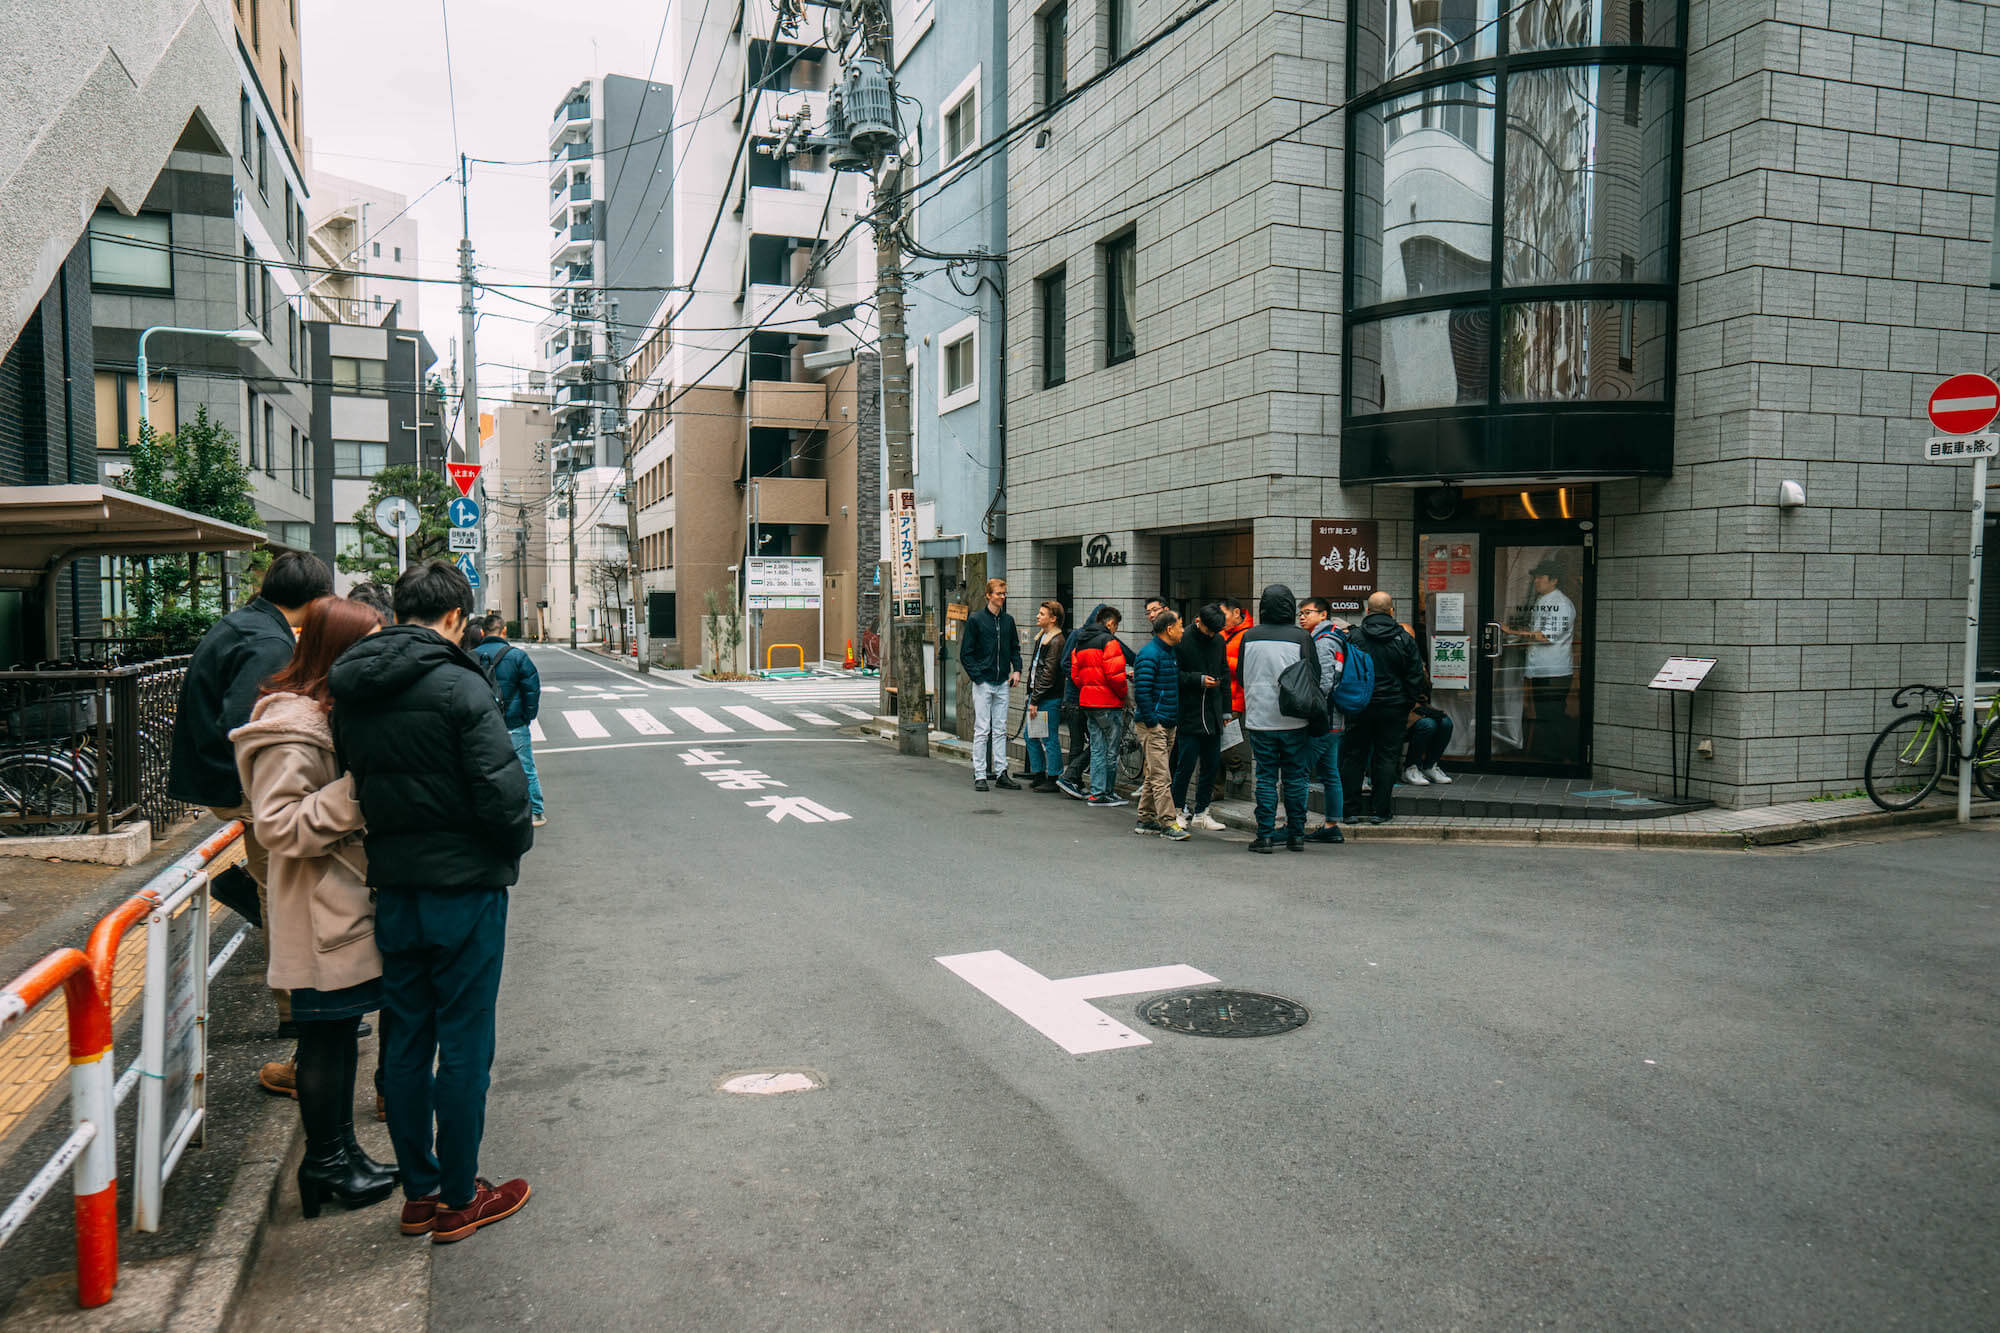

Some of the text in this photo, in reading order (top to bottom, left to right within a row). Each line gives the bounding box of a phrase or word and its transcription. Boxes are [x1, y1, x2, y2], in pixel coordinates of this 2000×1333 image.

[1930, 439, 1993, 456] 自転車を除く
[454, 470, 476, 478] 止まれ
[901, 492, 915, 510] 質
[1319, 546, 1371, 573] 鳴龍
[1331, 602, 1360, 610] CLOSED
[1434, 641, 1465, 649] スタッフ
[1434, 649, 1466, 662] 募集
[676, 748, 854, 824] 止まれ
